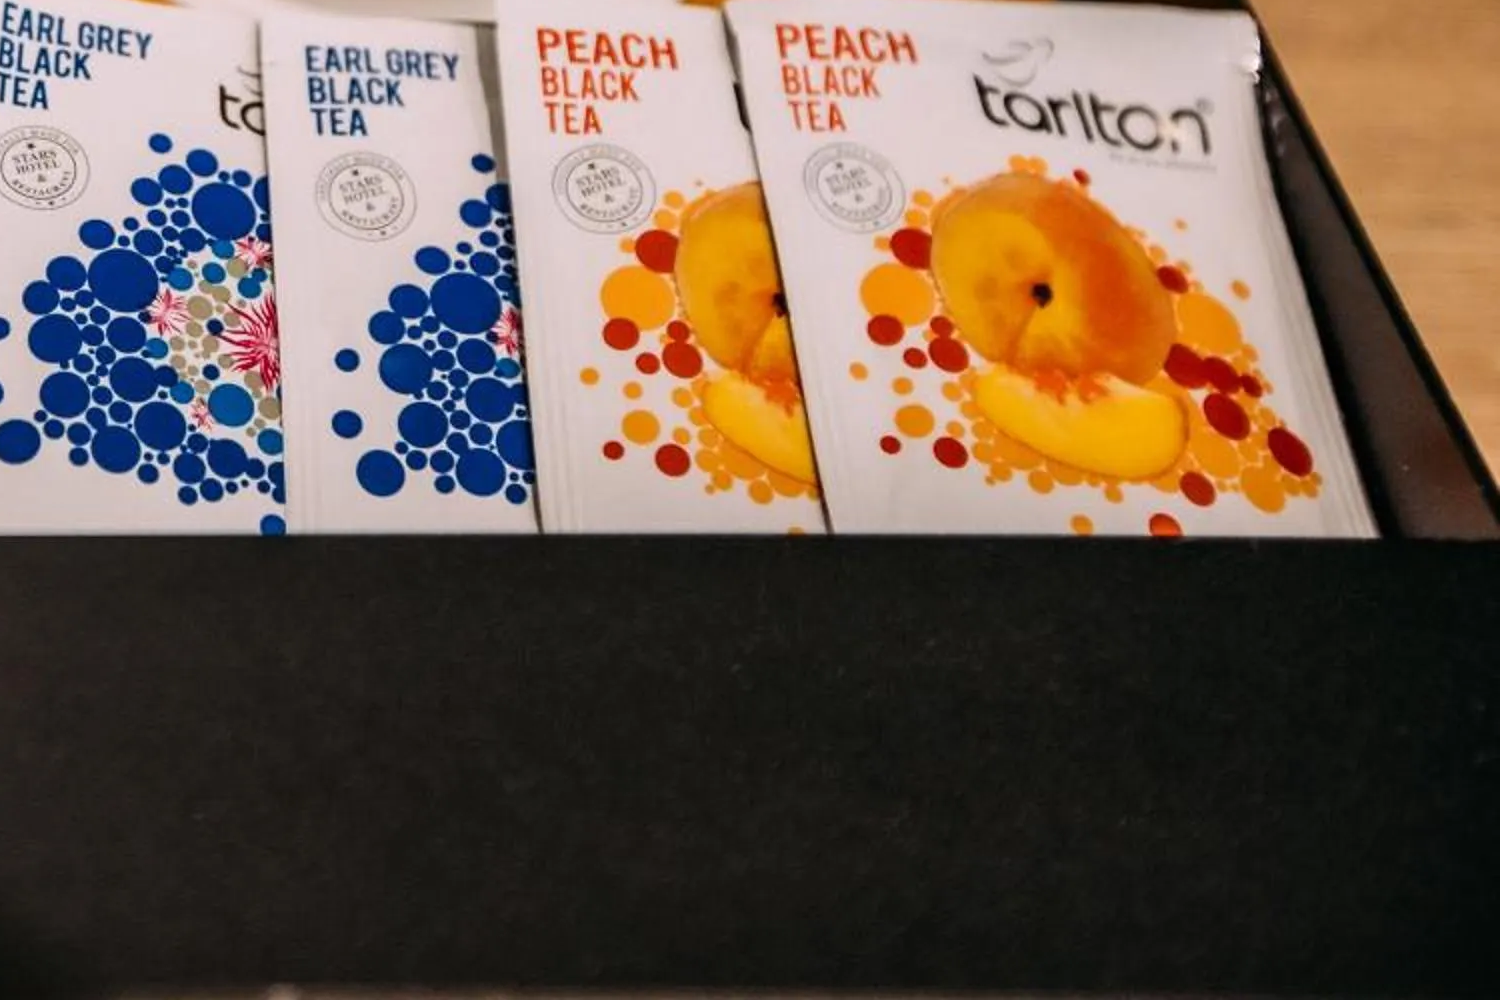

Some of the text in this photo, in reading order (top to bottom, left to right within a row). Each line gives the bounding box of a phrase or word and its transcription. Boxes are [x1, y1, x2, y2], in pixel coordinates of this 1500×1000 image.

[2, 0, 153, 61] EARL GREY
[775, 23, 918, 65] PEACH
[304, 44, 460, 81] EARL GREY
[536, 27, 679, 71] PEACH
[307, 76, 405, 107] BLACK
[541, 65, 640, 101] BLACK
[781, 63, 882, 98] BLACK
[309, 106, 369, 137] TEA
[543, 101, 603, 135] TEA
[787, 99, 847, 133] TEA
[972, 72, 1212, 156] tarlton
[12, 150, 57, 164] STARS
[15, 159, 61, 175] HOTEL
